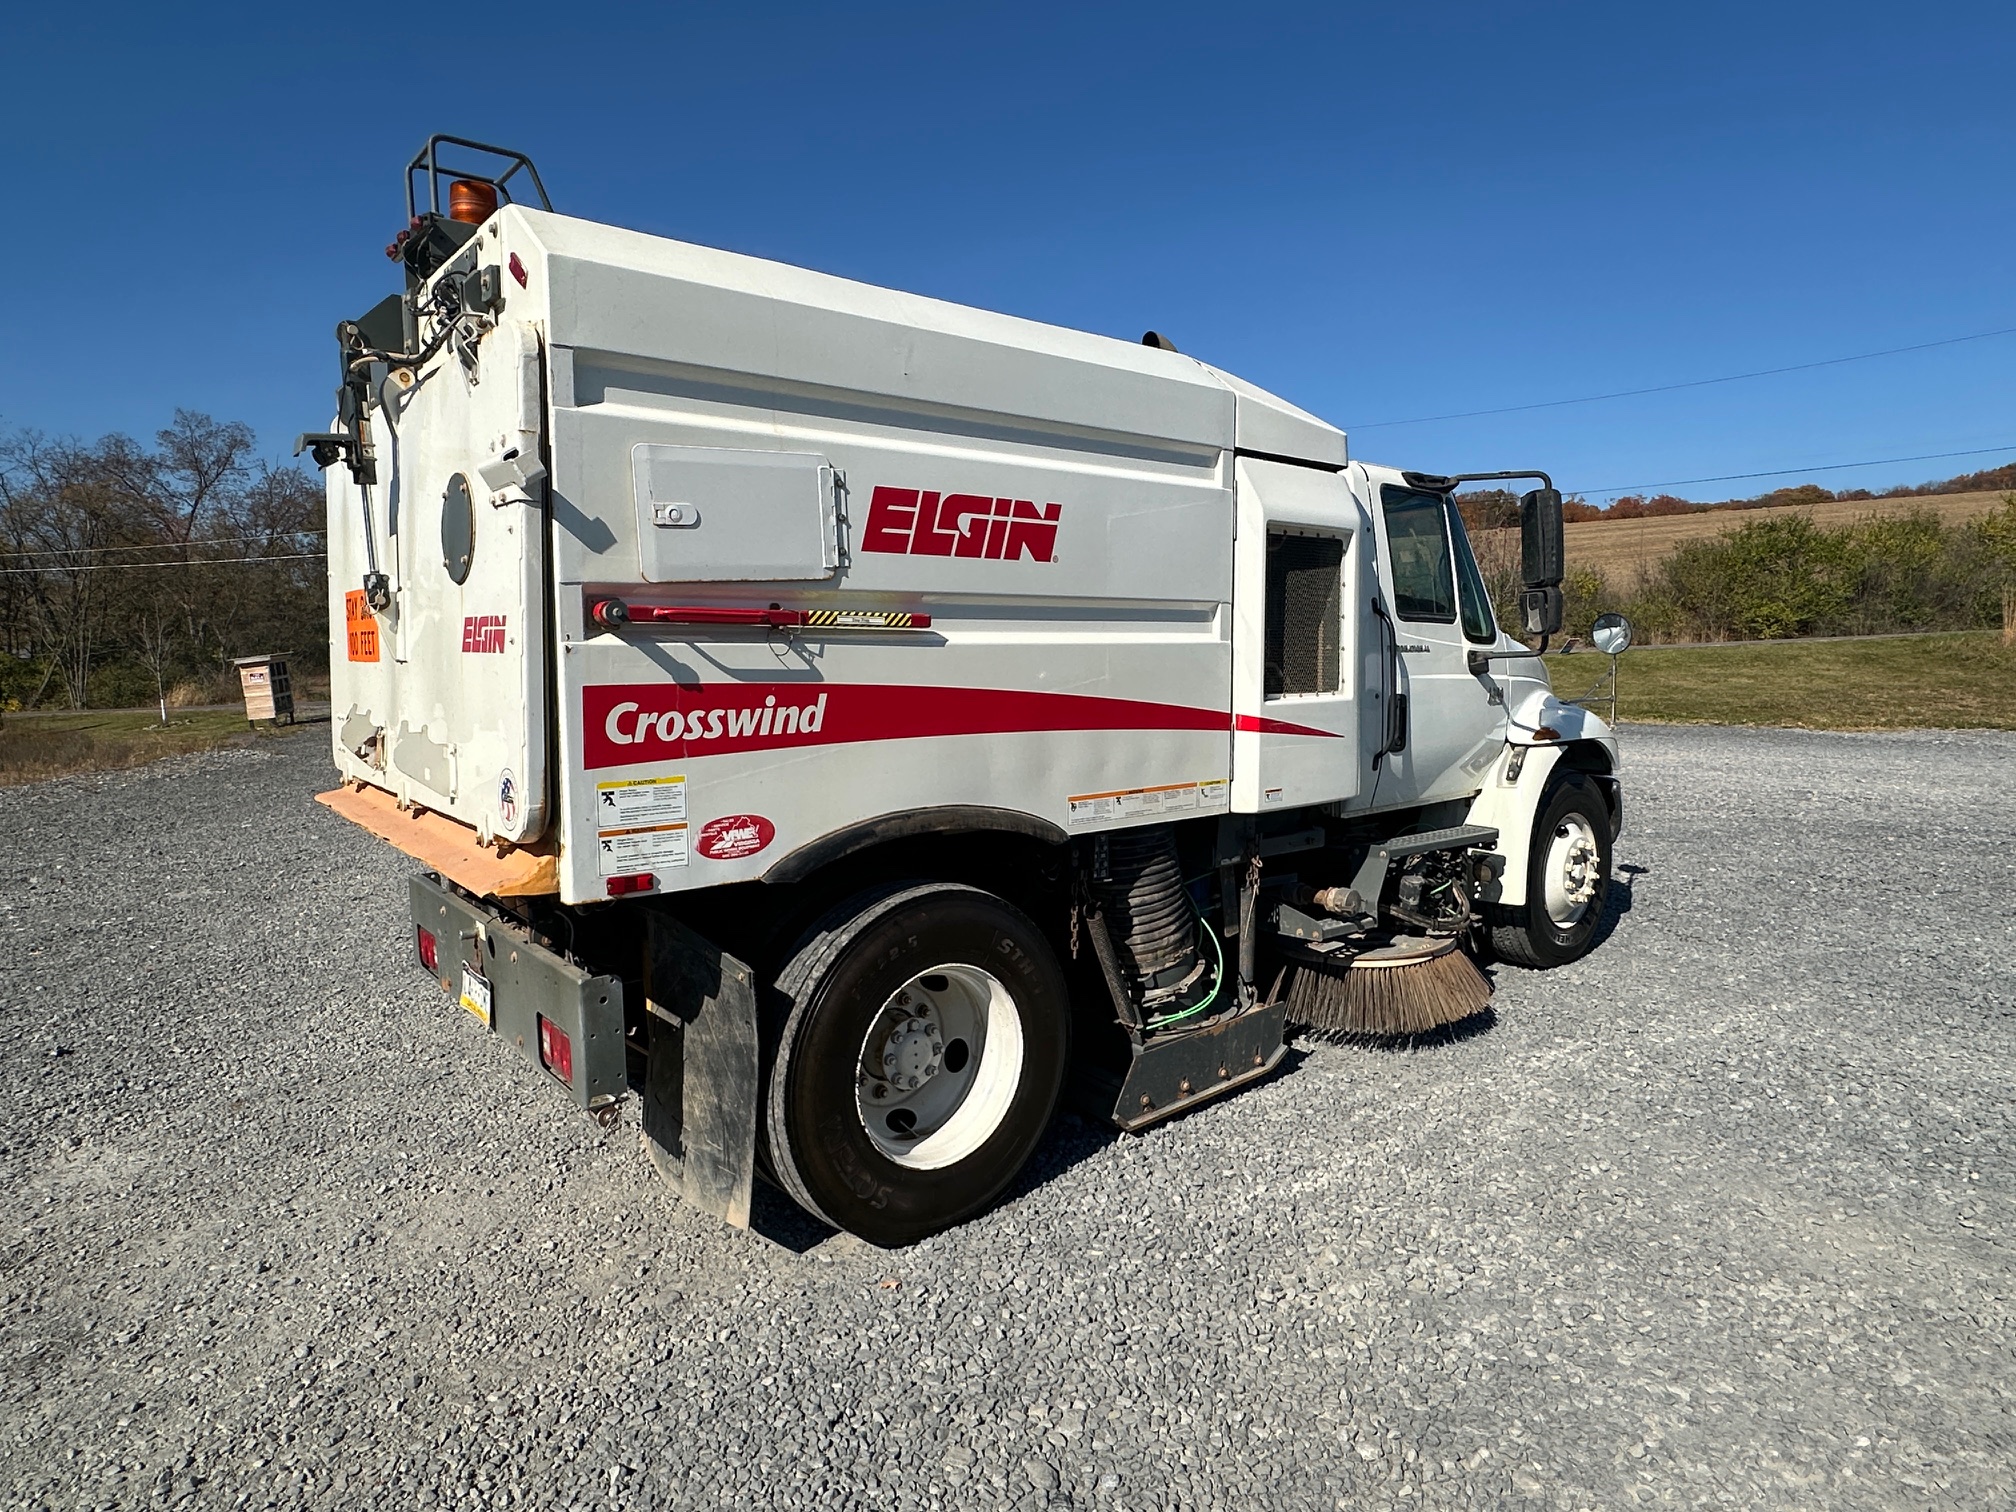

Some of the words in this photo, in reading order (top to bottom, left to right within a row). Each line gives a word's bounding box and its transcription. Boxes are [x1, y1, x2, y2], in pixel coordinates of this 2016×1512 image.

[861, 486, 1063, 563] ELGIN
[360, 630, 375, 656] FEET
[462, 615, 507, 654] ELGIN
[605, 693, 828, 745] Crosswind
